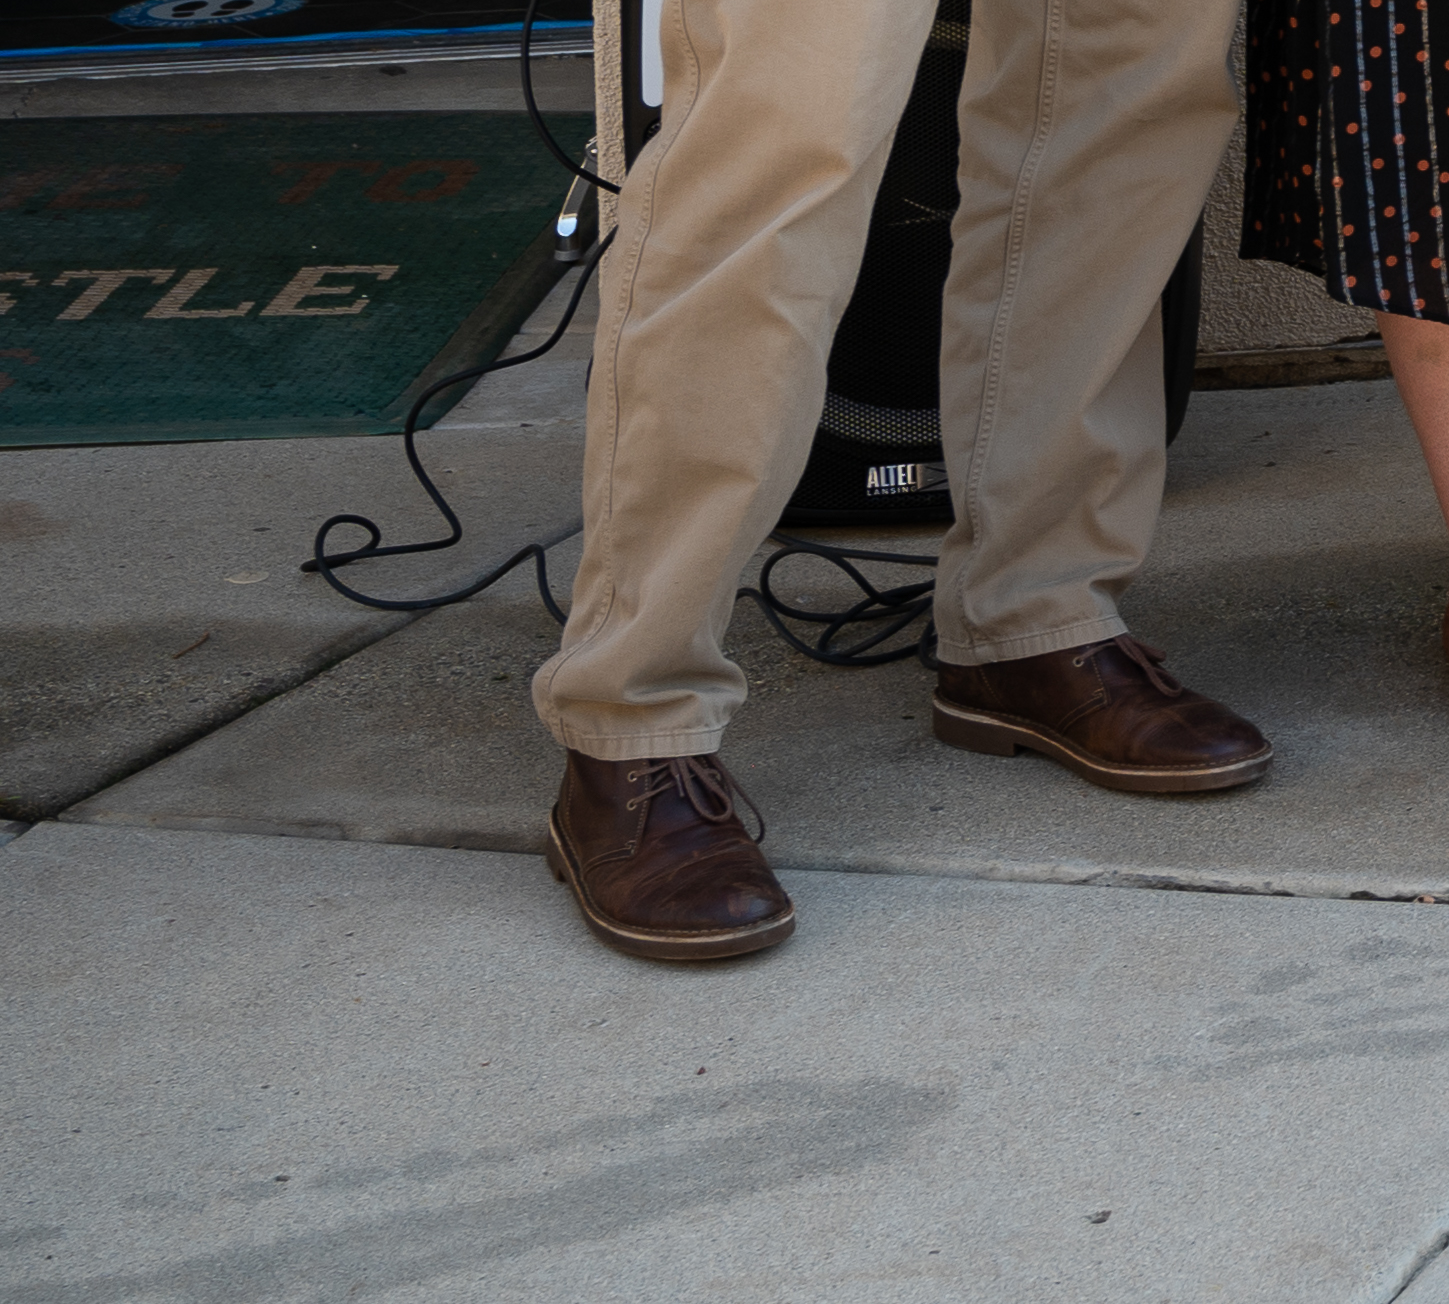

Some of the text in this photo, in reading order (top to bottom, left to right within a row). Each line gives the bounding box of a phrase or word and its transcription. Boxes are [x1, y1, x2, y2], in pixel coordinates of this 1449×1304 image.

[272, 159, 481, 204] TO
[866, 464, 917, 489] ALTEC
[866, 486, 917, 497] LANSING
